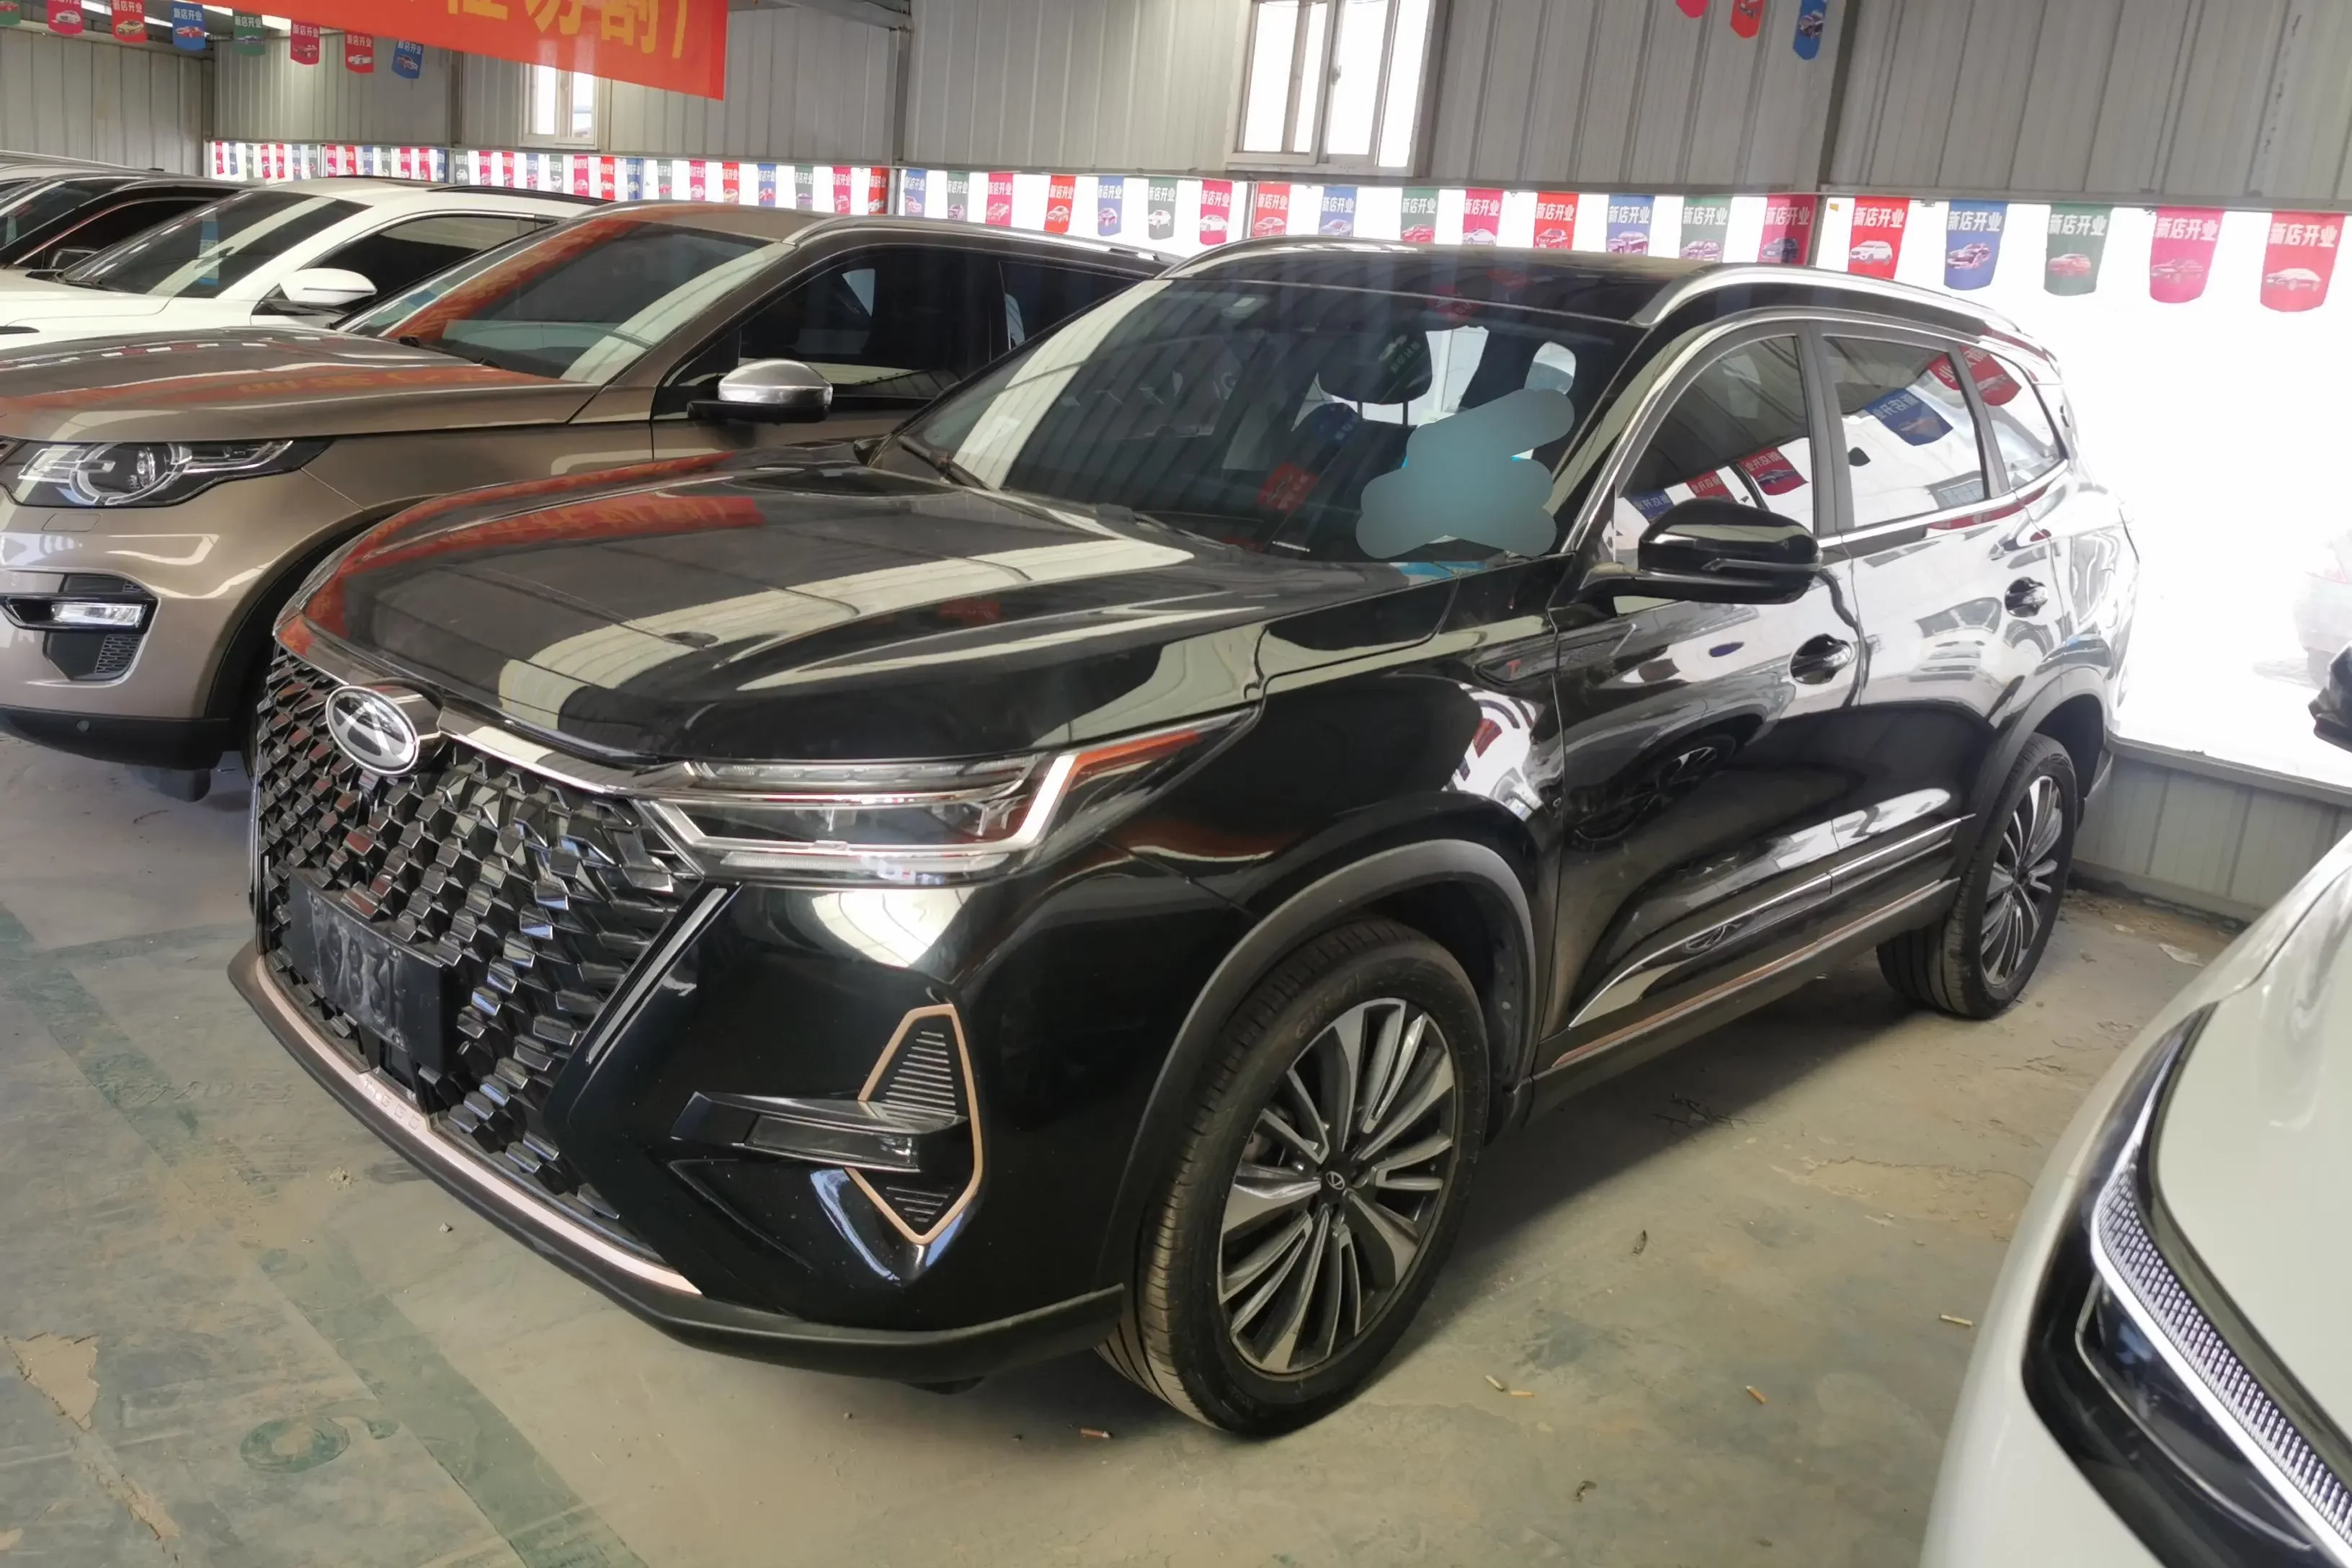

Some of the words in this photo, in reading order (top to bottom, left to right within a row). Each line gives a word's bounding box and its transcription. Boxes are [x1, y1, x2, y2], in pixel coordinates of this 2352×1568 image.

[988, 182, 1012, 195] 新店开业
[1049, 184, 1073, 199] 新店开业
[1097, 184, 1122, 199] 新店开业
[1149, 187, 1175, 202] 新店开业
[1201, 190, 1229, 208] 新店开业
[1257, 193, 1288, 210] 新店开业
[1322, 196, 1354, 213] 新店开业
[1402, 197, 1435, 214] 新店开业
[1464, 198, 1499, 215] 新店开业
[1536, 202, 1574, 221] 新店开业
[1608, 205, 1649, 223] 新店开业
[1682, 205, 1727, 225] 新店开业
[1765, 206, 1809, 226] 新店开业
[1853, 207, 1904, 228] 新店开业
[1947, 210, 2002, 232] 新店开业
[2048, 213, 2106, 236] 新店开业
[2155, 216, 2219, 241] 新店开业
[2268, 222, 2338, 247] 新店开业
